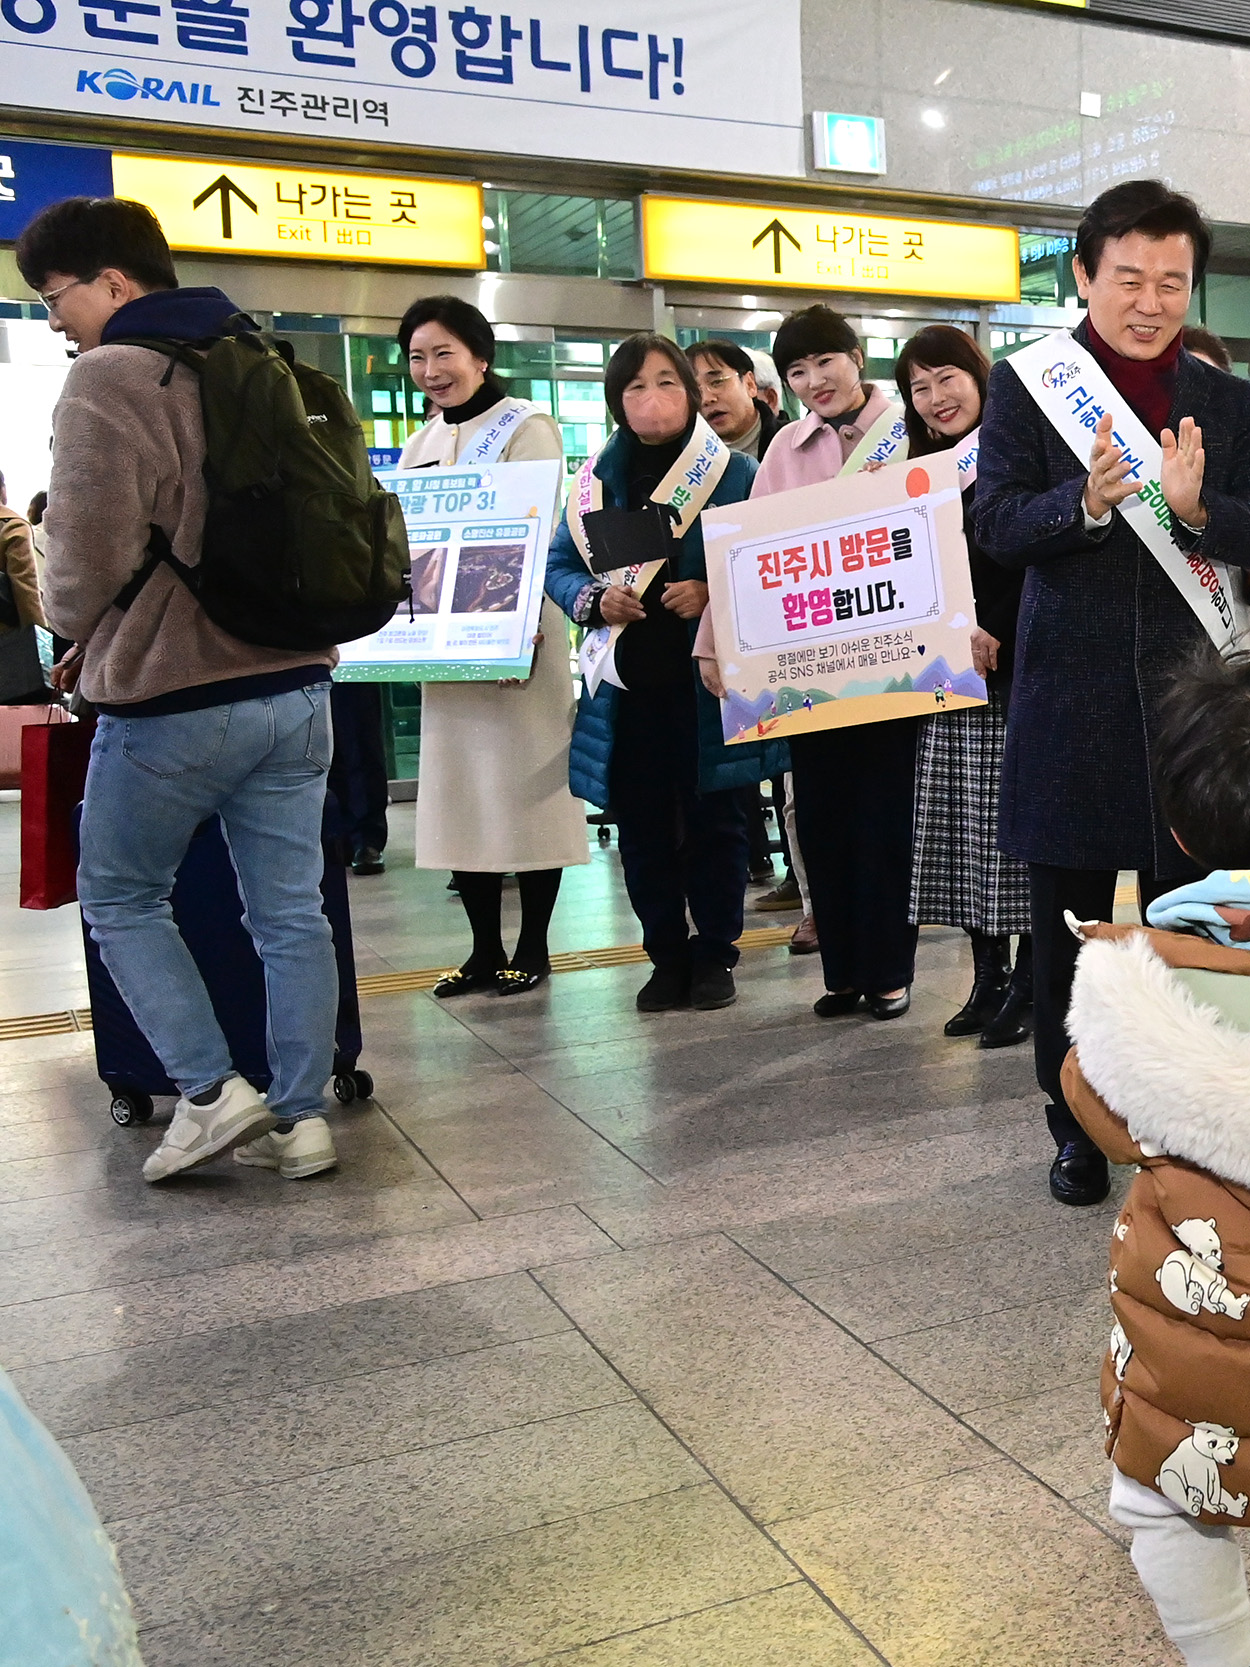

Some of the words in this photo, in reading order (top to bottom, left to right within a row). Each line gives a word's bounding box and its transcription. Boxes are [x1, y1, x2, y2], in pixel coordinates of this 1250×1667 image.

[286, 0, 684, 100] 환영합니다!
[76, 68, 221, 107] KORAIL
[237, 86, 390, 128] 진주관리역
[276, 182, 372, 220] 나가는
[389, 190, 417, 225] 곳
[277, 224, 312, 242] Exit
[337, 228, 371, 246] 出口
[816, 224, 890, 257] 나가는
[903, 231, 925, 260] 곳
[433, 492, 472, 514] TOP
[476, 490, 496, 511] 3!
[757, 540, 833, 590] 진주시
[839, 526, 912, 574] 방문을
[782, 580, 904, 632] 환영합니다.
[768, 668, 788, 683] 공식
[790, 664, 814, 678] SNS
[816, 657, 856, 675] 채널에서
[858, 652, 878, 668] 매일
[777, 648, 816, 667] 명절에만
[818, 645, 838, 659] 보기
[841, 639, 871, 656] 아쉬운
[873, 630, 913, 651] 진주소식
